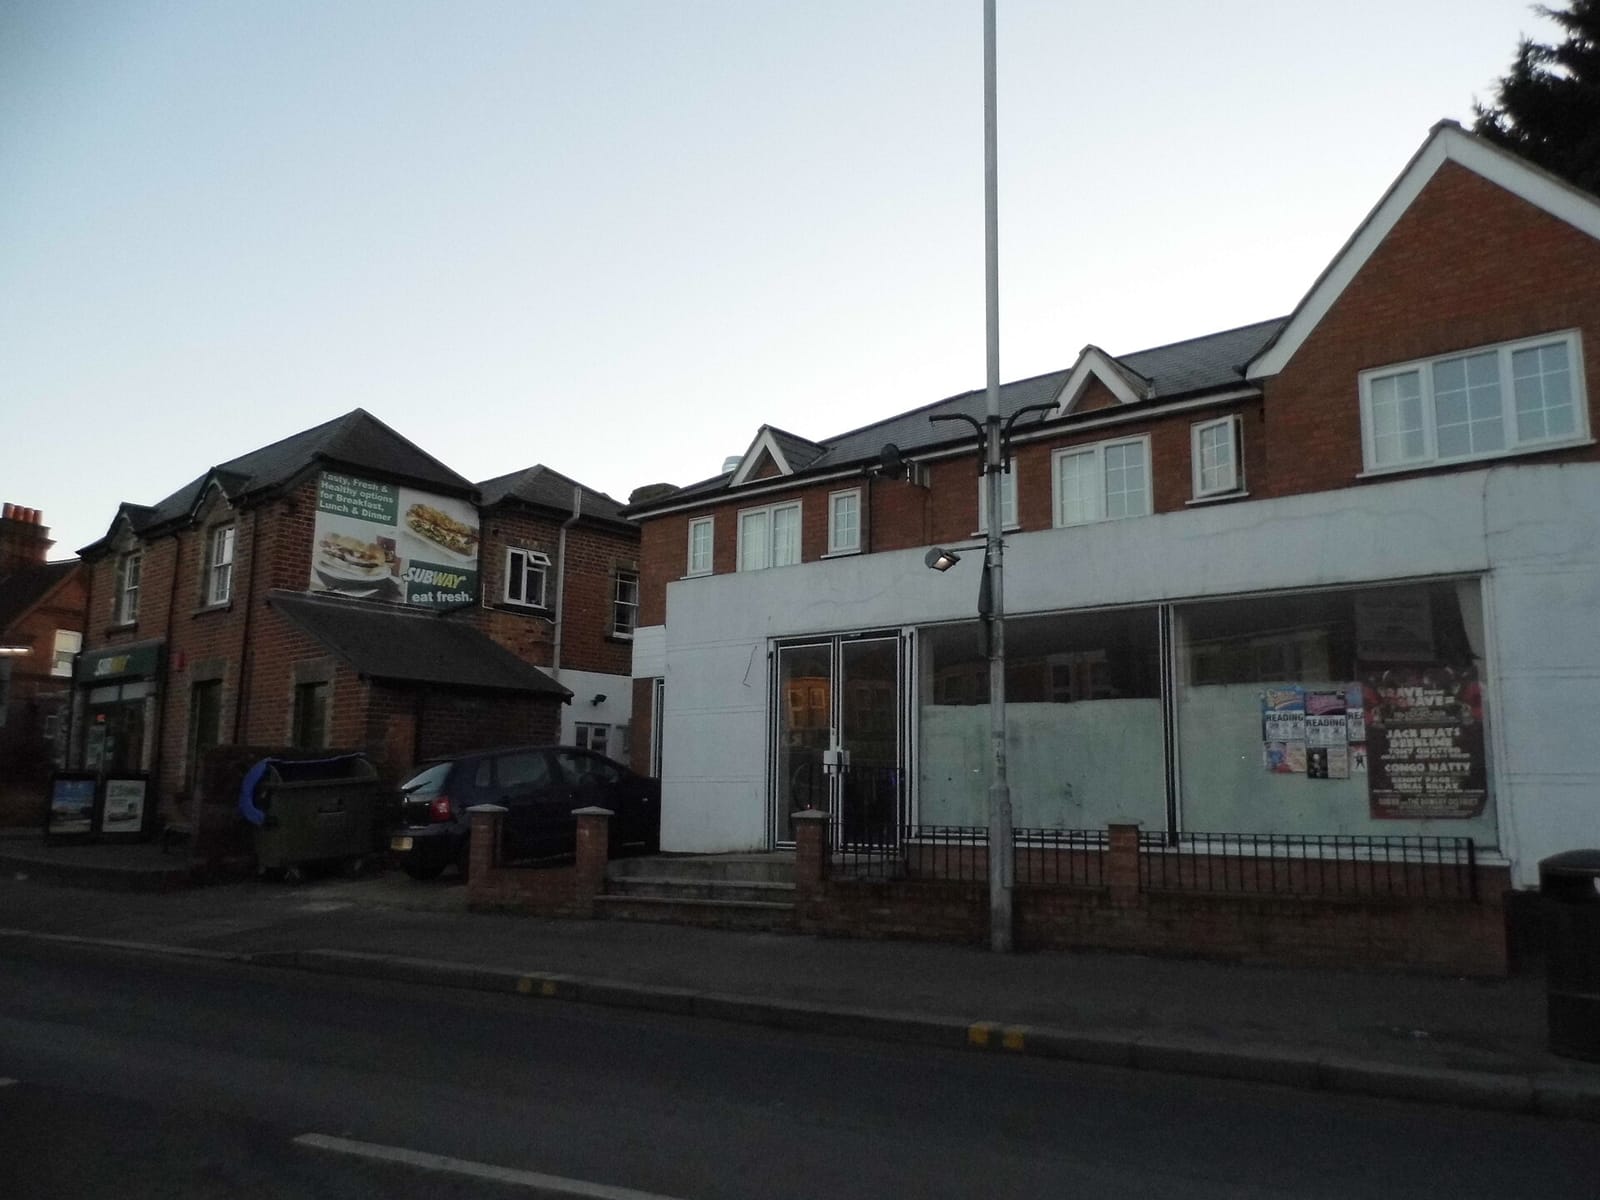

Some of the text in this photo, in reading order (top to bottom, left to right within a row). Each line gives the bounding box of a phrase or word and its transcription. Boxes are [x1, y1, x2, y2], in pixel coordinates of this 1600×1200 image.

[320, 480, 394, 504] Healthy options
[322, 471, 389, 493] Tasty, Fresh &
[319, 489, 385, 513] for Breakfast,
[319, 499, 393, 522] Lunch & Dinner
[403, 567, 463, 589] SUBWAY
[412, 591, 434, 602] eat
[1266, 713, 1304, 722] READING
[1306, 719, 1345, 727] READING
